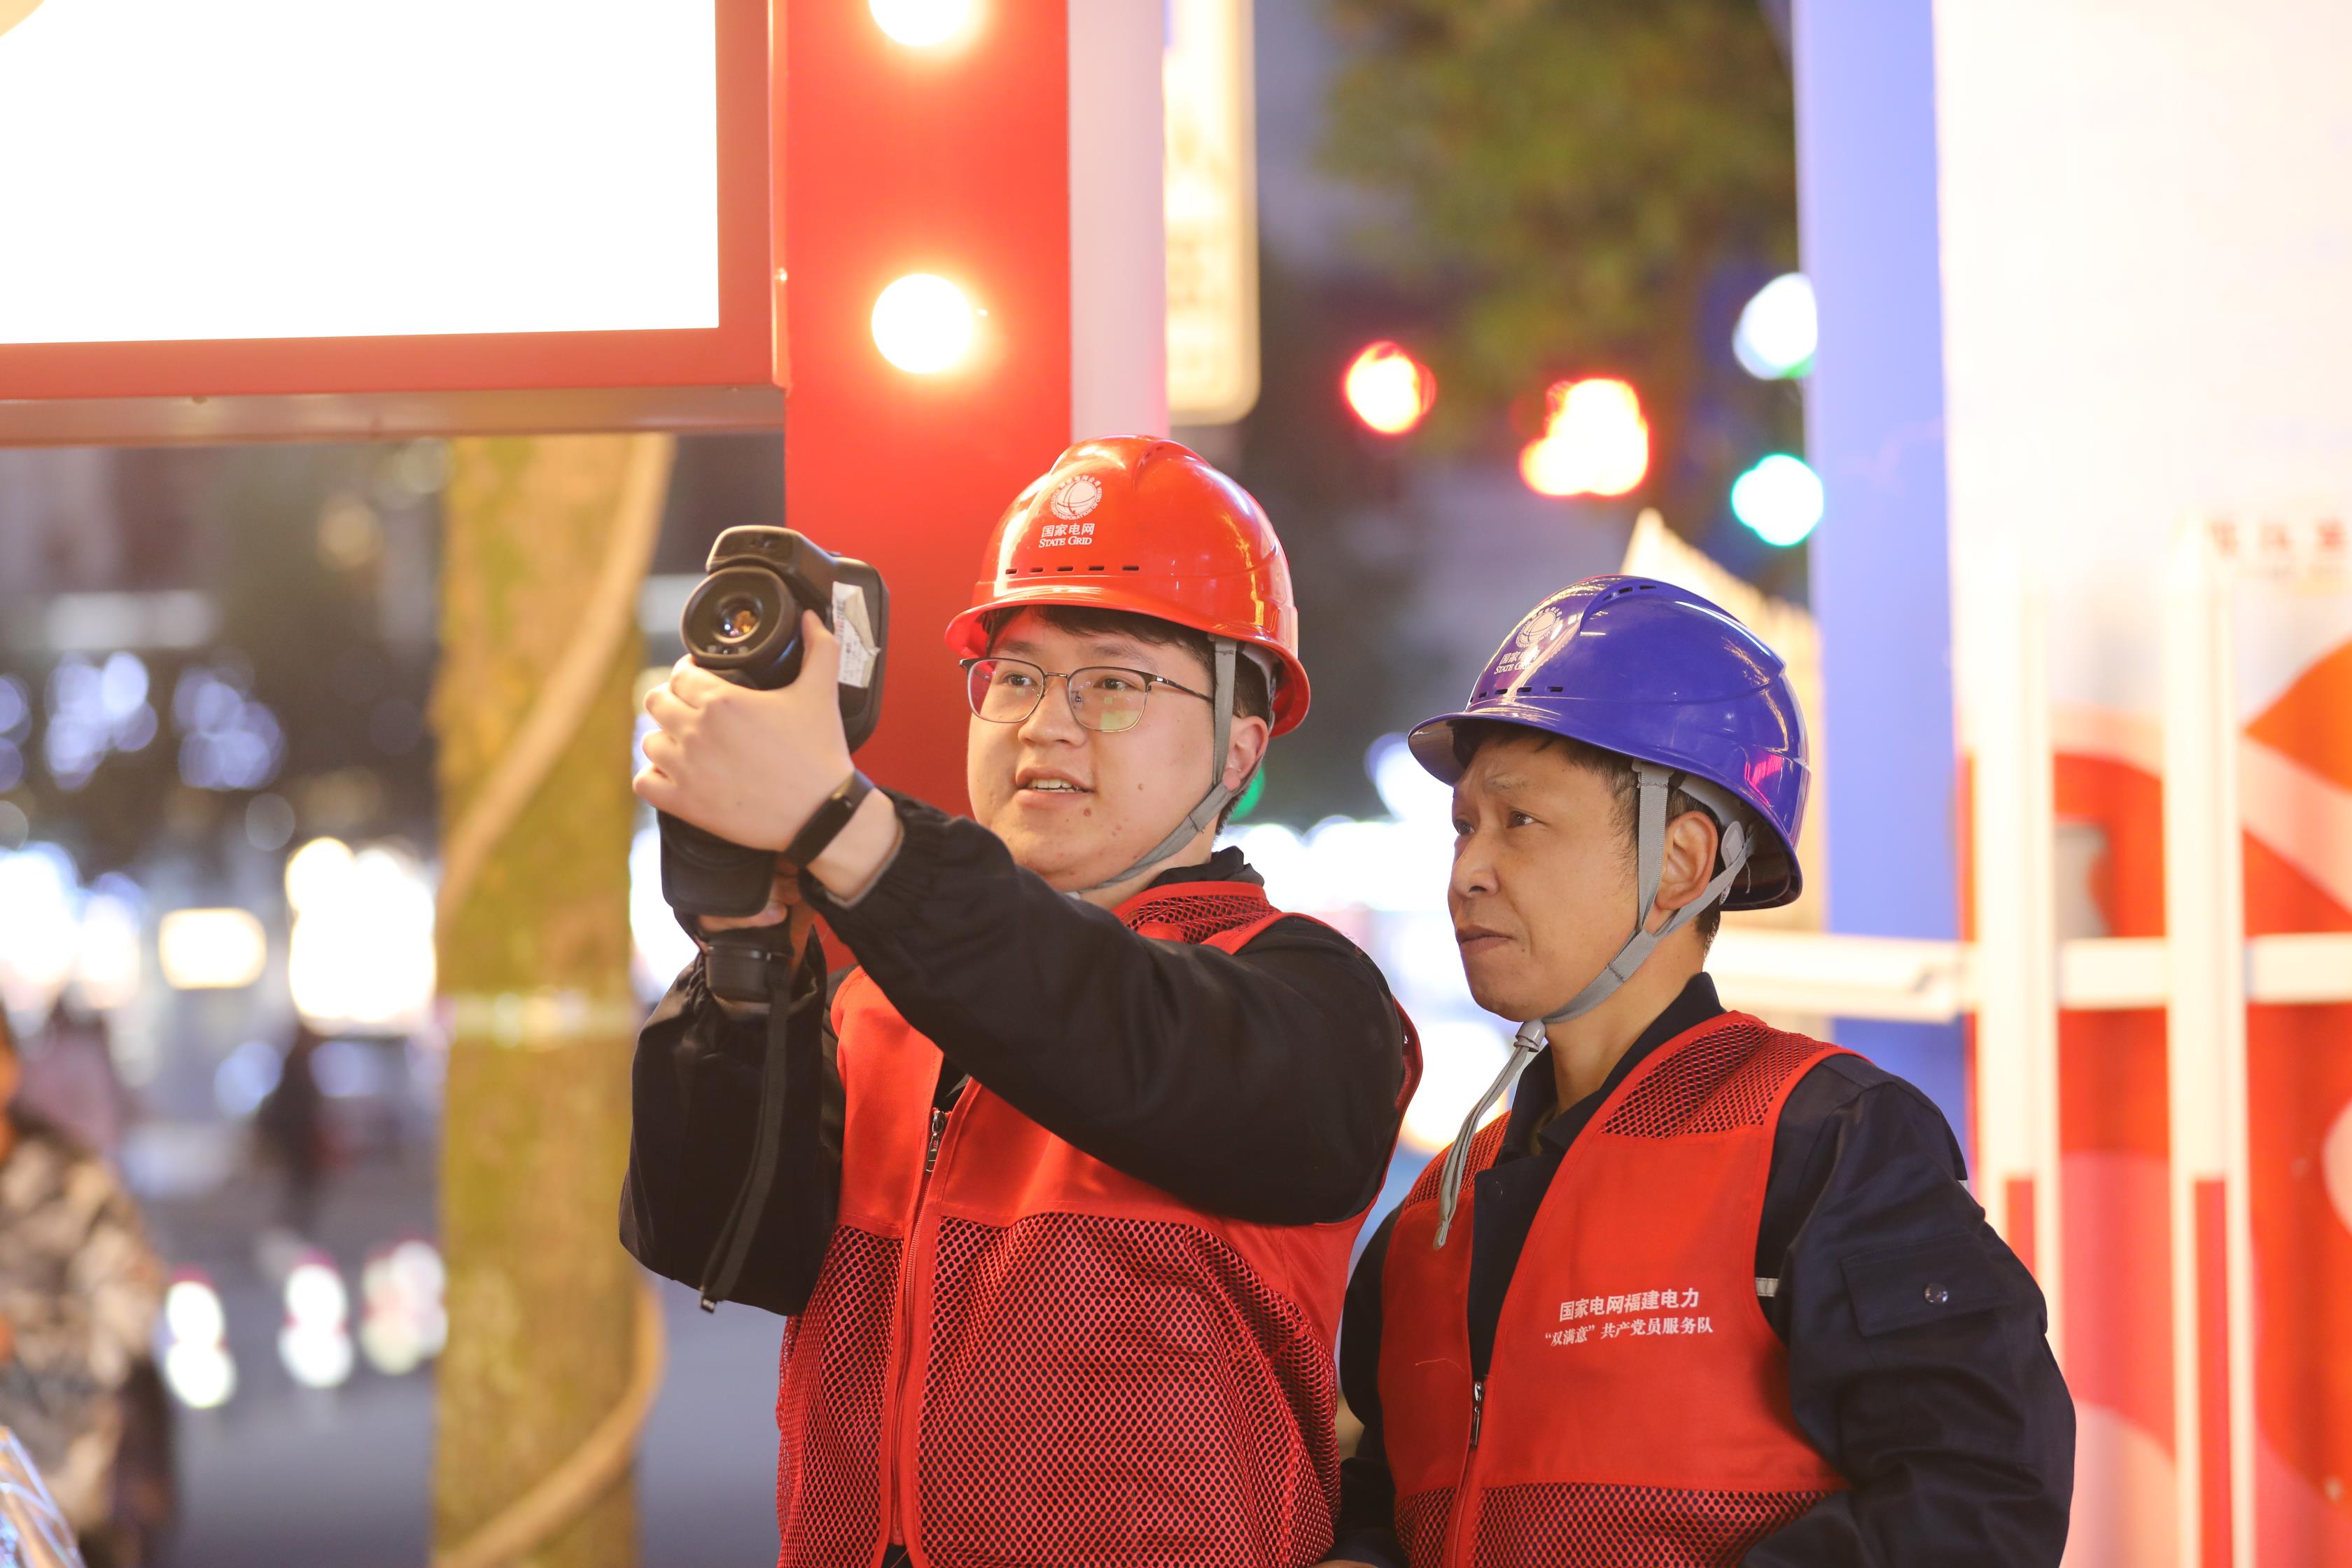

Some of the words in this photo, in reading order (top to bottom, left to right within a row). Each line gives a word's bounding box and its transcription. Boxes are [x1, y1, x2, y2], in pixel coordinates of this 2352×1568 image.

[1042, 523, 1095, 538] 国家电网
[1038, 538, 1066, 548] STATE
[1068, 536, 1093, 545] GRID
[1499, 651, 1541, 665] 国家电
[1494, 664, 1514, 674] STATE
[1559, 1287, 1700, 1322] 国家电网福建电力
